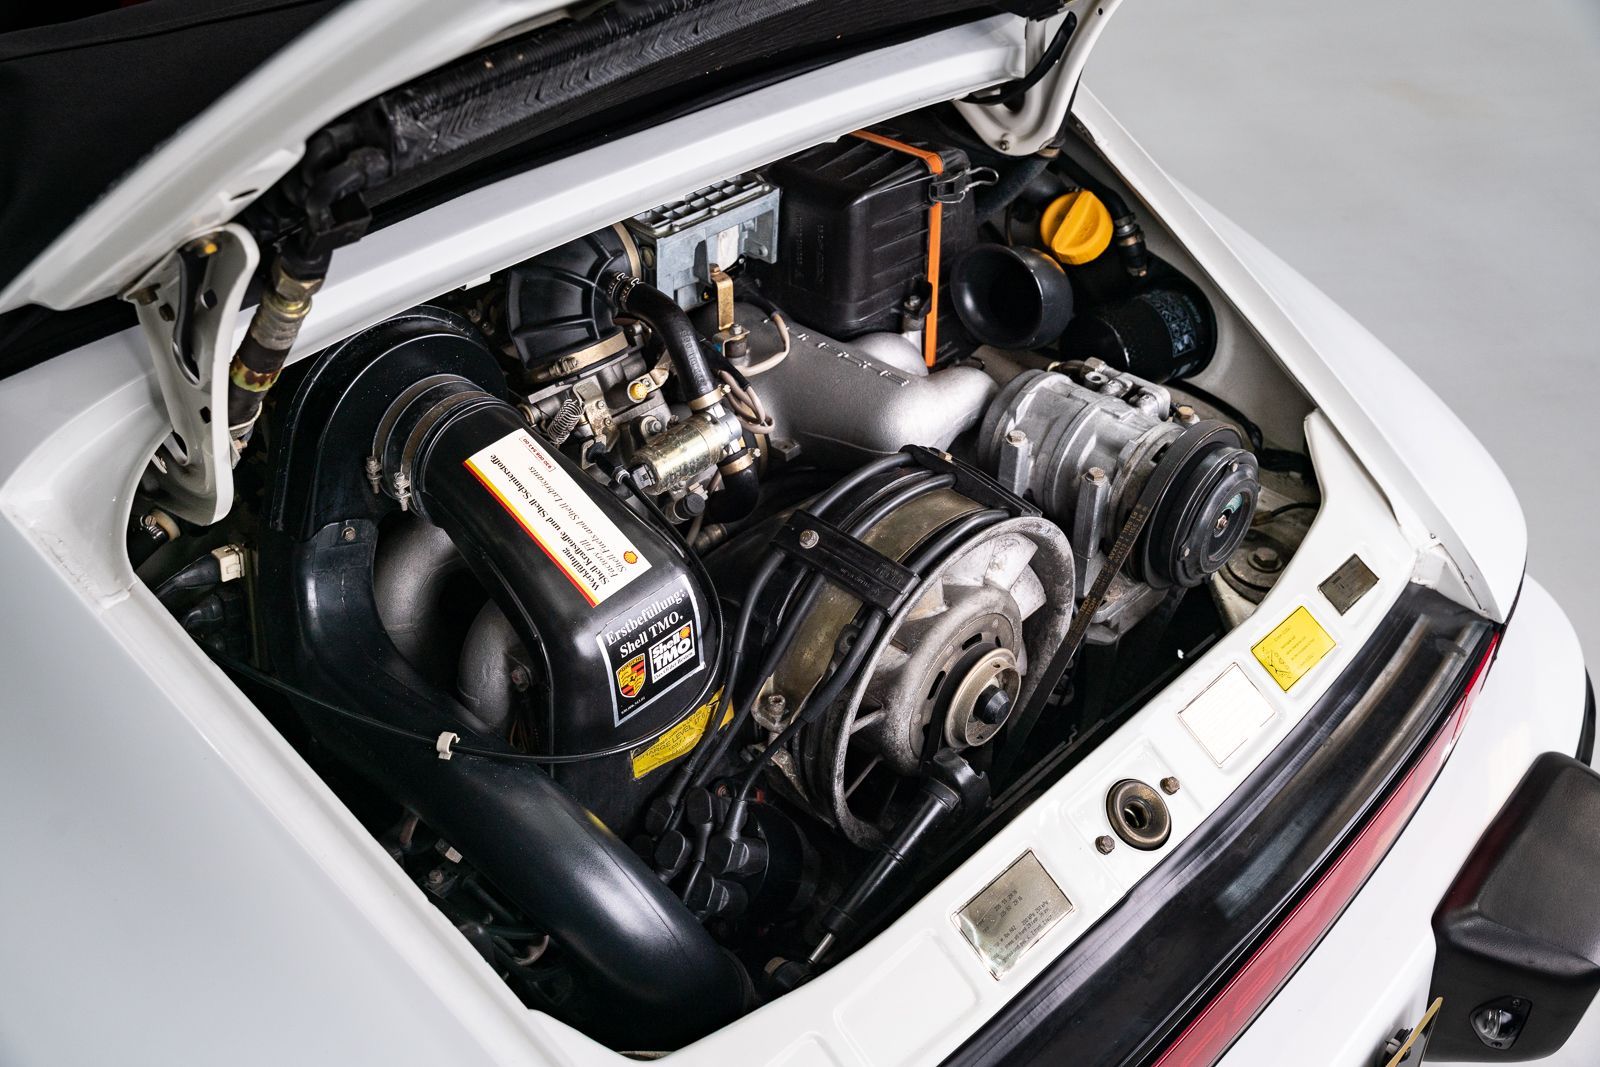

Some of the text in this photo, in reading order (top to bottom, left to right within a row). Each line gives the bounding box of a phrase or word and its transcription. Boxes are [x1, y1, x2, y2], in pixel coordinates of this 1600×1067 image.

[489, 453, 609, 585] Shell Kraftstoffe und Shell Schmierstoffe
[528, 465, 627, 572] Shell Fuels and Shell Lubricants
[562, 546, 600, 591] Werkfüllung
[579, 538, 618, 578] Factory Fill
[605, 589, 685, 646] Erstbefüllung:
[619, 611, 684, 658] Shell TMO.
[653, 631, 681, 659] Shell
[653, 638, 691, 671] TMO
[671, 724, 692, 743] LEVEL
